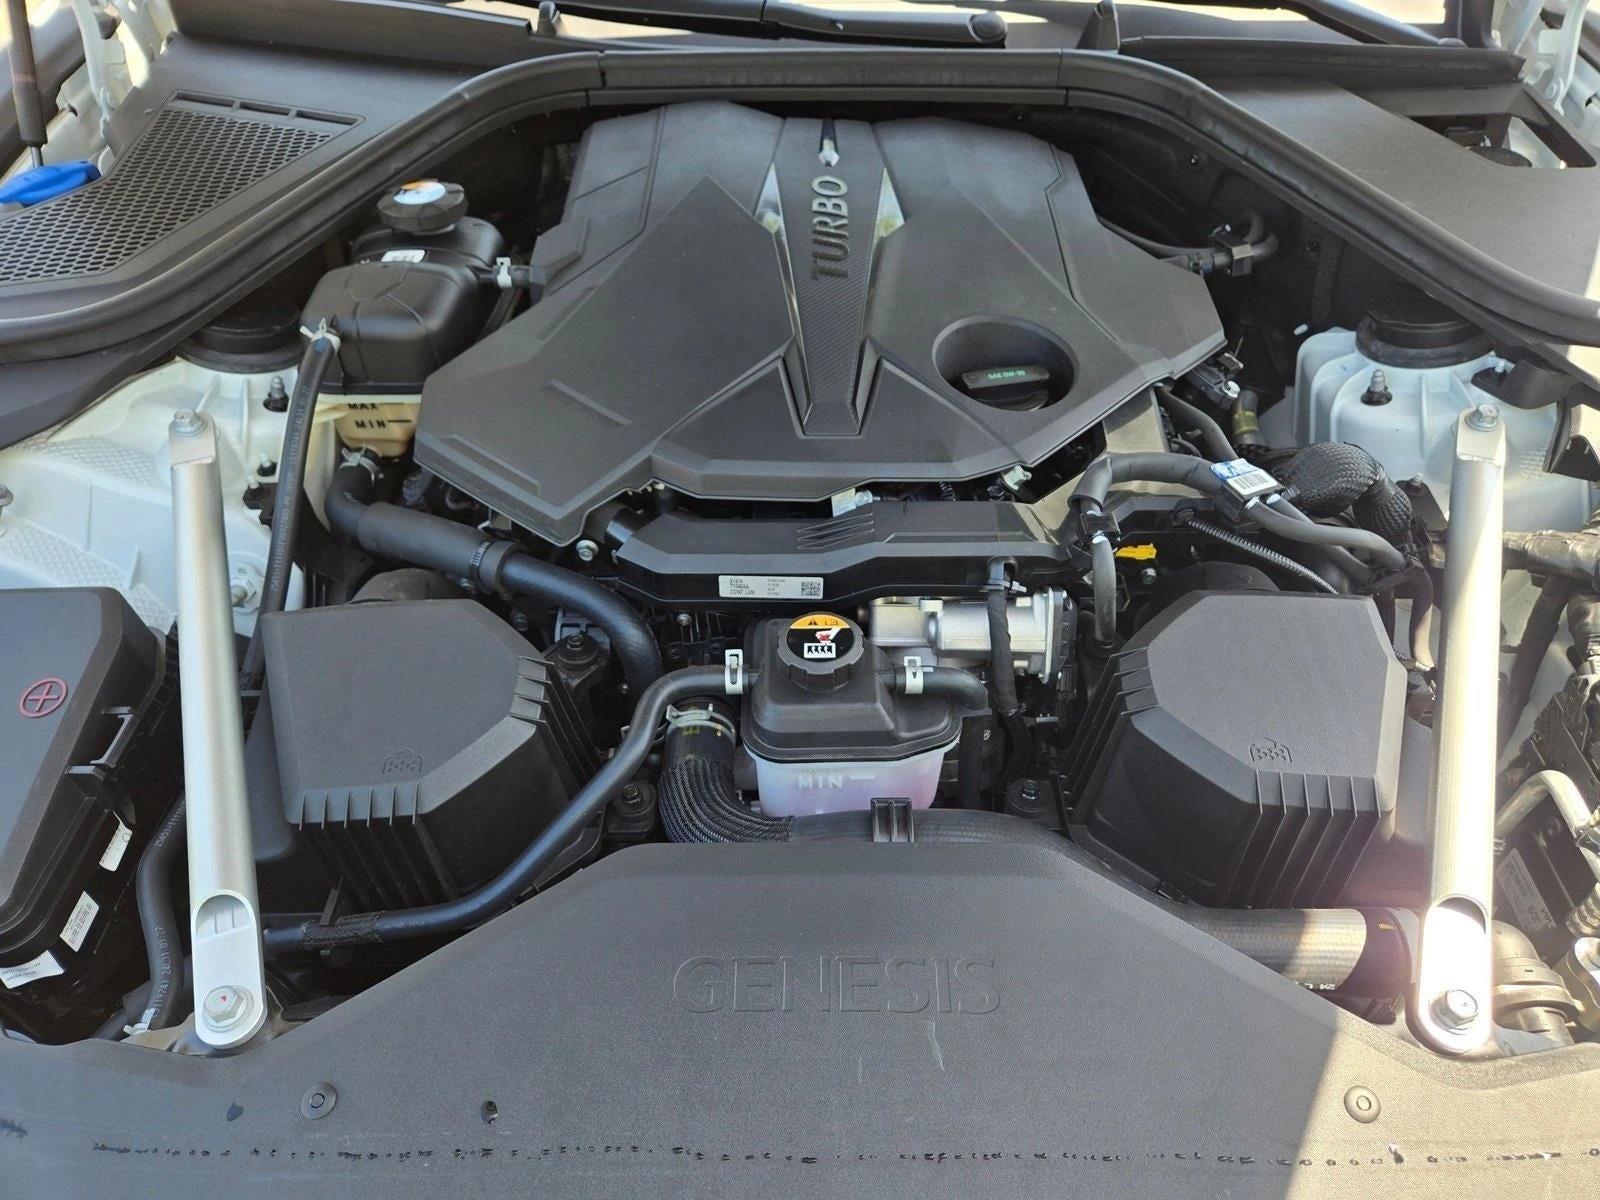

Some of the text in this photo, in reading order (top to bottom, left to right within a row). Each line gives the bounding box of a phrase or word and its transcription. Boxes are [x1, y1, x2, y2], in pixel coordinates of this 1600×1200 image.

[811, 176, 849, 279] TURBO
[347, 402, 378, 410] MAX
[355, 419, 387, 428] MIN
[798, 775, 843, 789] MIN
[674, 956, 1001, 1014] GENESIS
